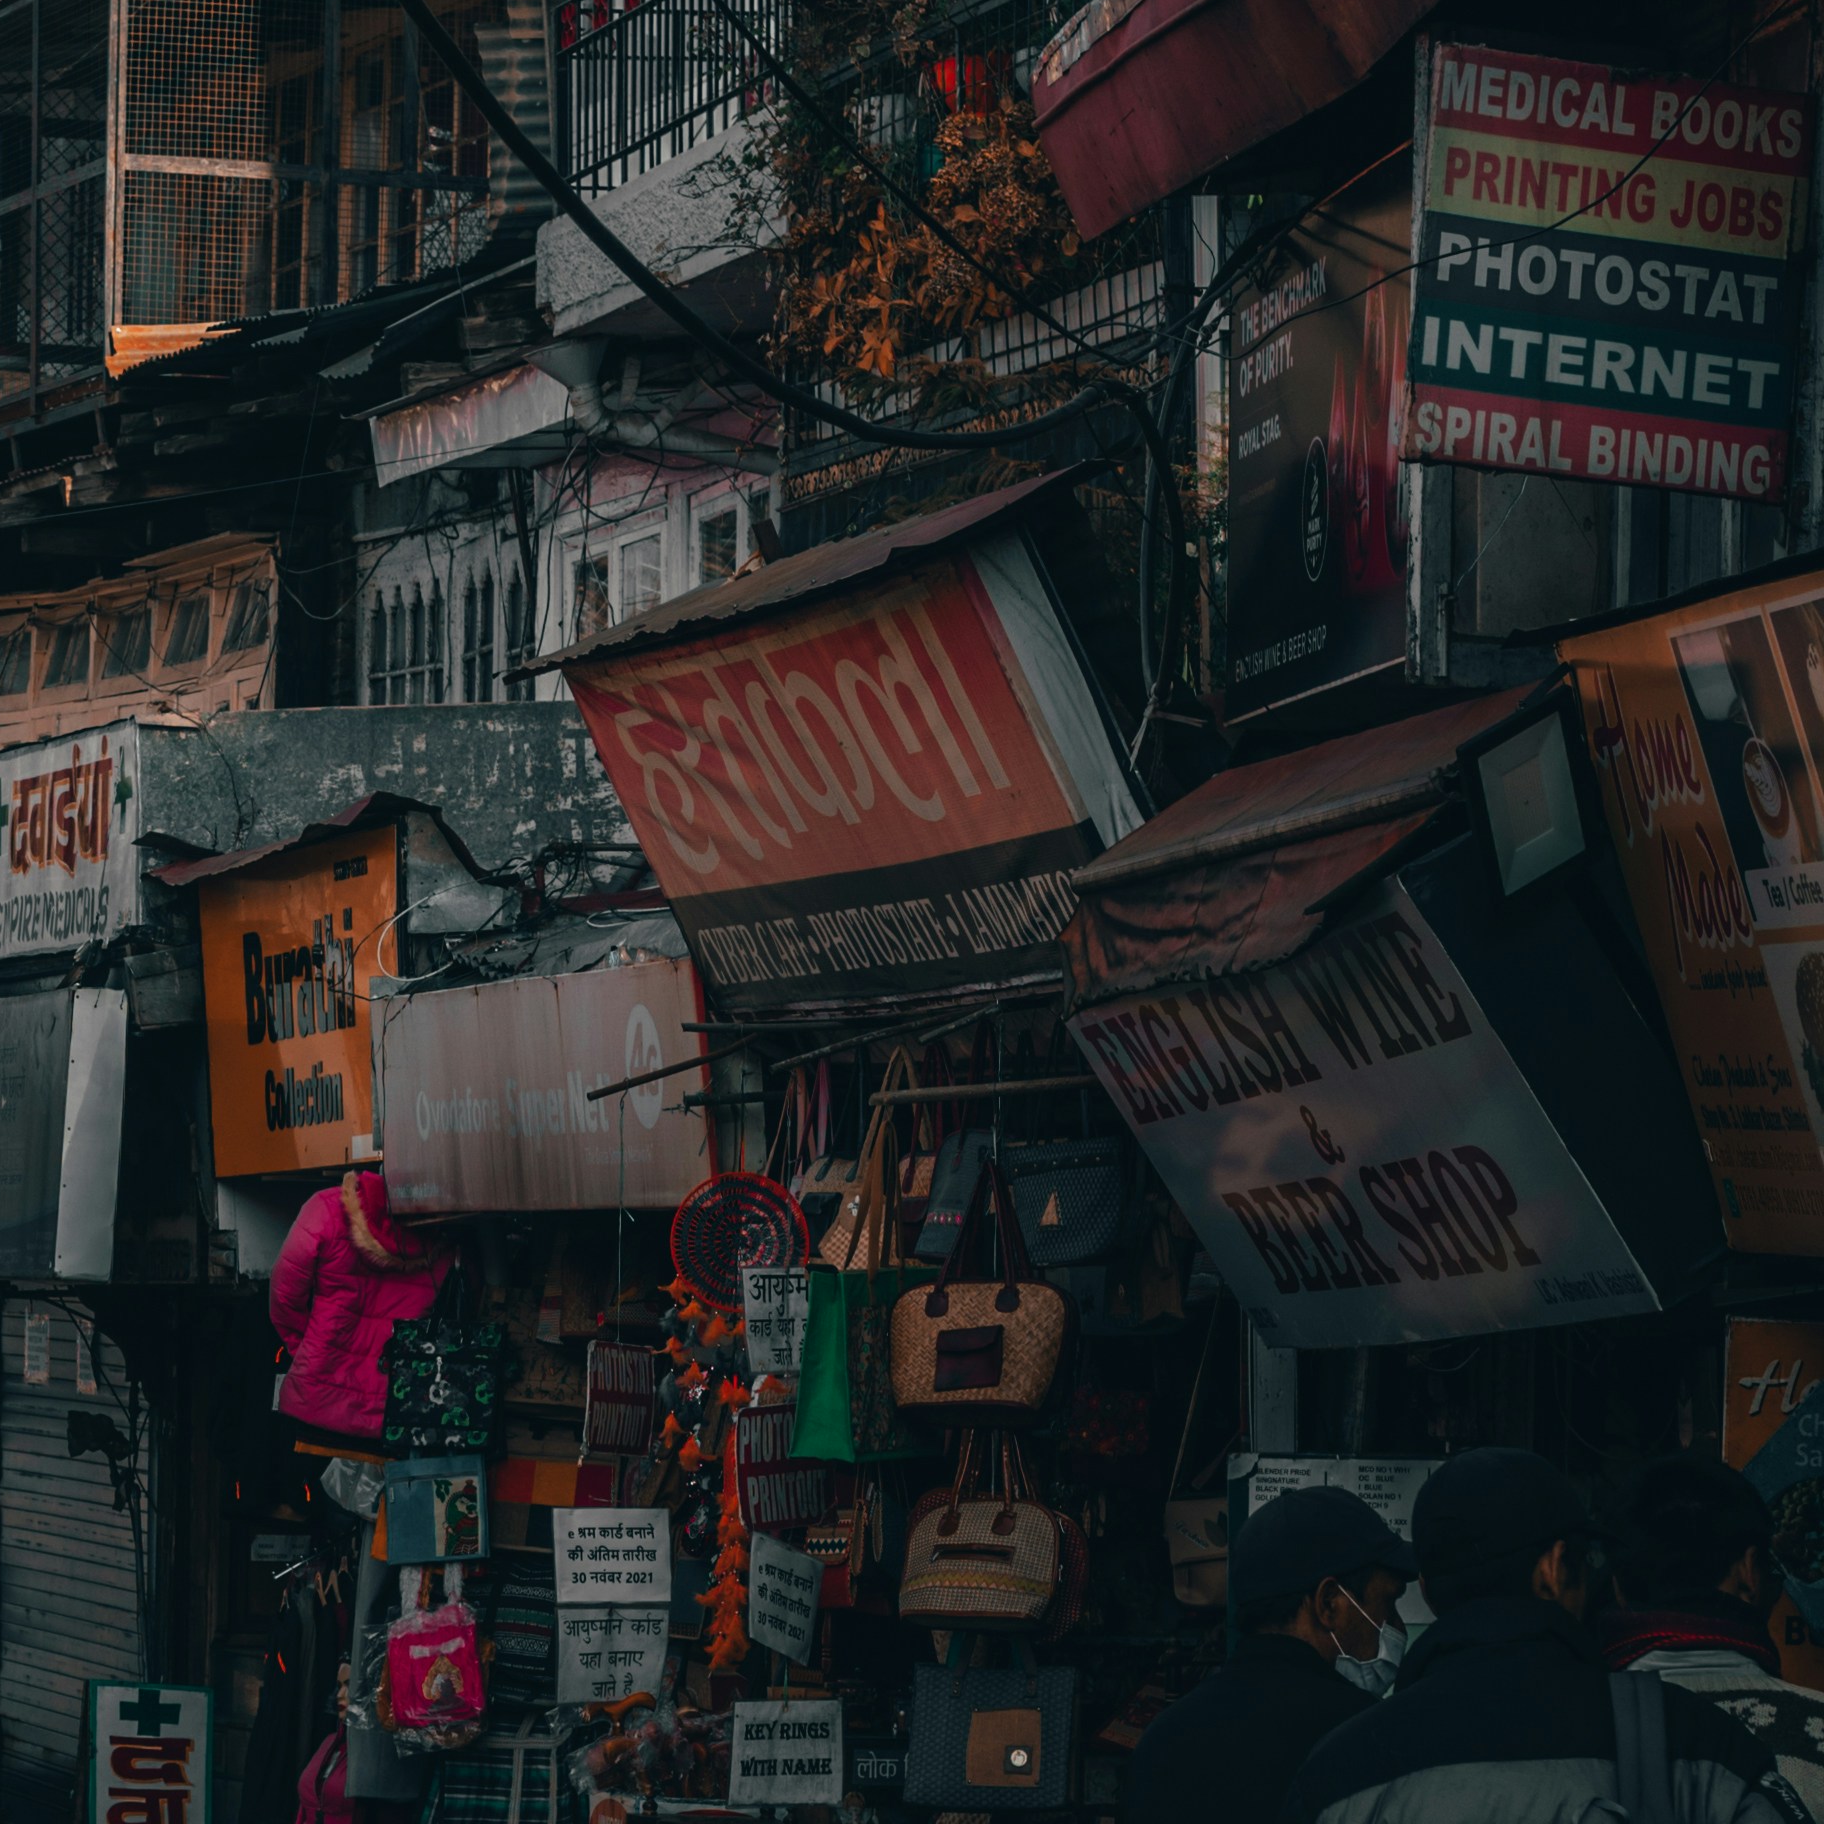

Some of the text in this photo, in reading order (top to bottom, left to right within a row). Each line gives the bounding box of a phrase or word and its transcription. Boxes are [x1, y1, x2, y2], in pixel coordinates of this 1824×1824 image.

[1441, 60, 1804, 159] MEDICAL BOOKS
[1443, 146, 1784, 242] PRINTING JOBS
[1240, 256, 1327, 347] THE BENCHMARK
[1436, 231, 1778, 326] PHOTOSTAT
[1239, 332, 1294, 398] OF PURITY.
[1421, 316, 1781, 410] INTERNET
[1238, 424, 1260, 460] ROYAL
[1414, 402, 1771, 496] SPIRAL BINDING
[1264, 642, 1280, 673] WINE
[1288, 634, 1307, 663] BEER
[1307, 624, 1327, 656] SHOP
[1592, 660, 1702, 848] Home
[41, 884, 110, 943] MEDICALS
[1660, 819, 1753, 982] Made
[1762, 879, 1785, 908] Tea
[1789, 873, 1824, 905] Coffee
[698, 865, 1082, 987] CYBER CAFE PHOTOSTATE LAMINATIO
[1080, 911, 1473, 1125] ENGLISH WINE
[264, 1061, 344, 1133] Collection
[1299, 1105, 1346, 1166] &
[1221, 1144, 1543, 1295] BEER SHOP
[749, 1312, 772, 1337] कार्ड
[592, 1343, 651, 1396] PHOTOSTAT
[593, 1405, 647, 1448] PRINTOUT
[747, 1469, 826, 1524] PRINTOUT
[600, 1519, 624, 1539] कार्ड
[627, 1522, 656, 1540] बनाने
[622, 1545, 657, 1563] तारीख
[571, 1571, 587, 1585] 30
[625, 1570, 654, 1584] 2021
[786, 1623, 806, 1642] 2021
[592, 1674, 617, 1698] जाते
[744, 1720, 830, 1742] KEY RINGS
[740, 1756, 832, 1778] WITH NAME
[855, 1748, 898, 1781] लोक
